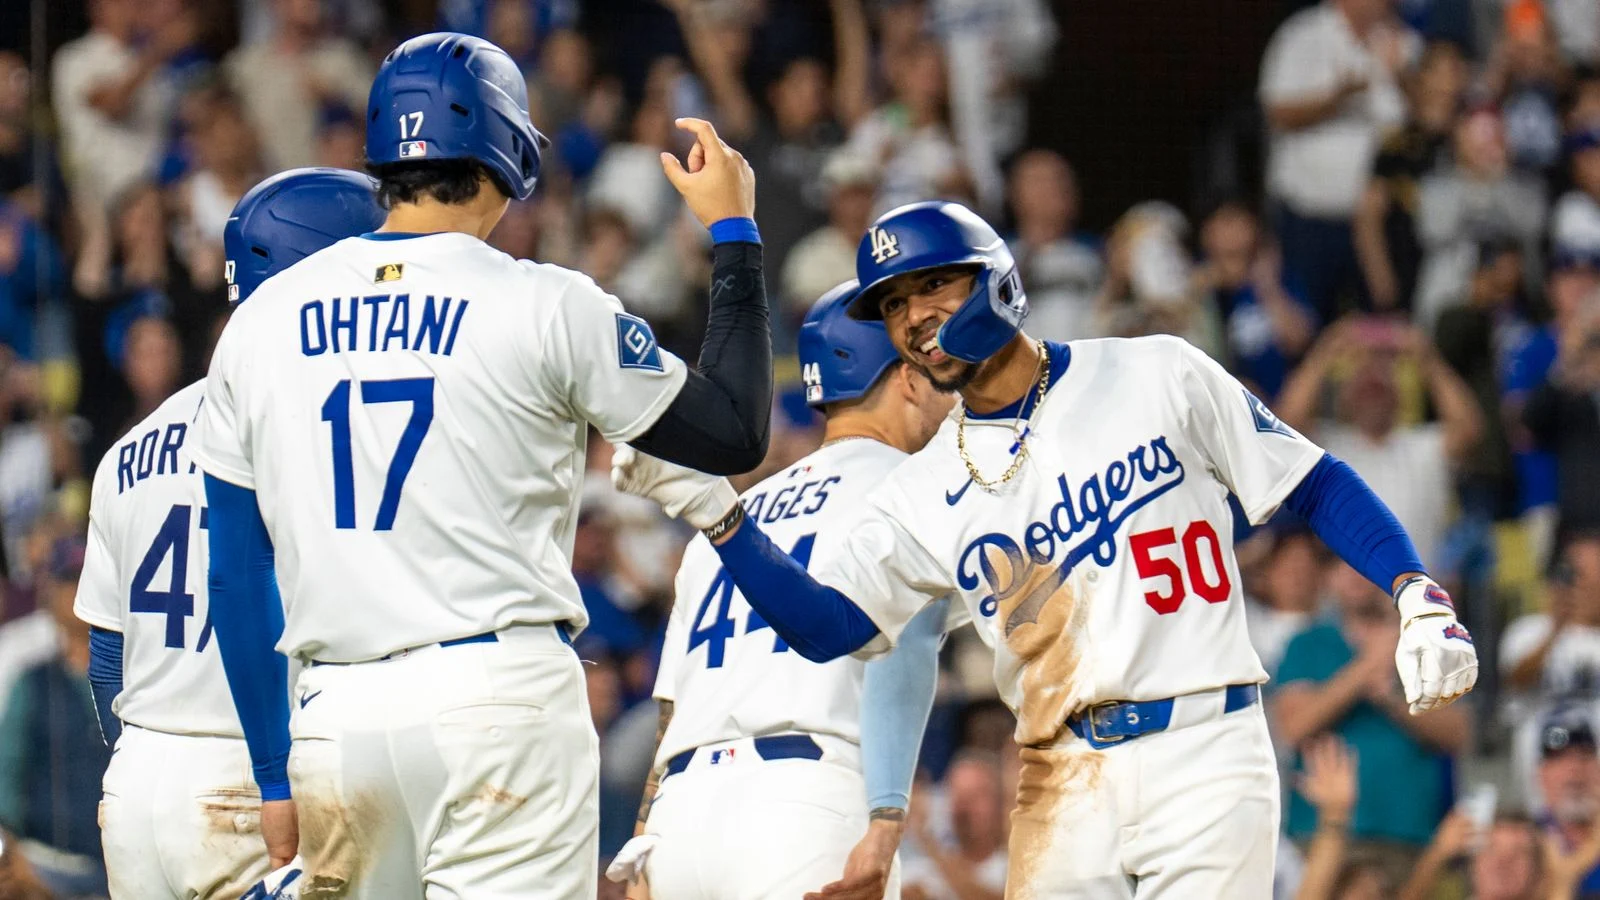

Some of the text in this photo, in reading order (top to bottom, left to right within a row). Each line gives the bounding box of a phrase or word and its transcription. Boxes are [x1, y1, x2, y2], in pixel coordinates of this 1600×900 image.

[399, 111, 424, 140] 17
[868, 225, 900, 264] LA
[300, 293, 469, 357] OHTANI
[803, 361, 821, 386] 44
[117, 422, 197, 496] ROR
[321, 376, 435, 531] 17
[741, 475, 841, 524] AGES
[957, 435, 1185, 630] Dodgers
[129, 504, 213, 652] 4
[1129, 520, 1231, 615] 50
